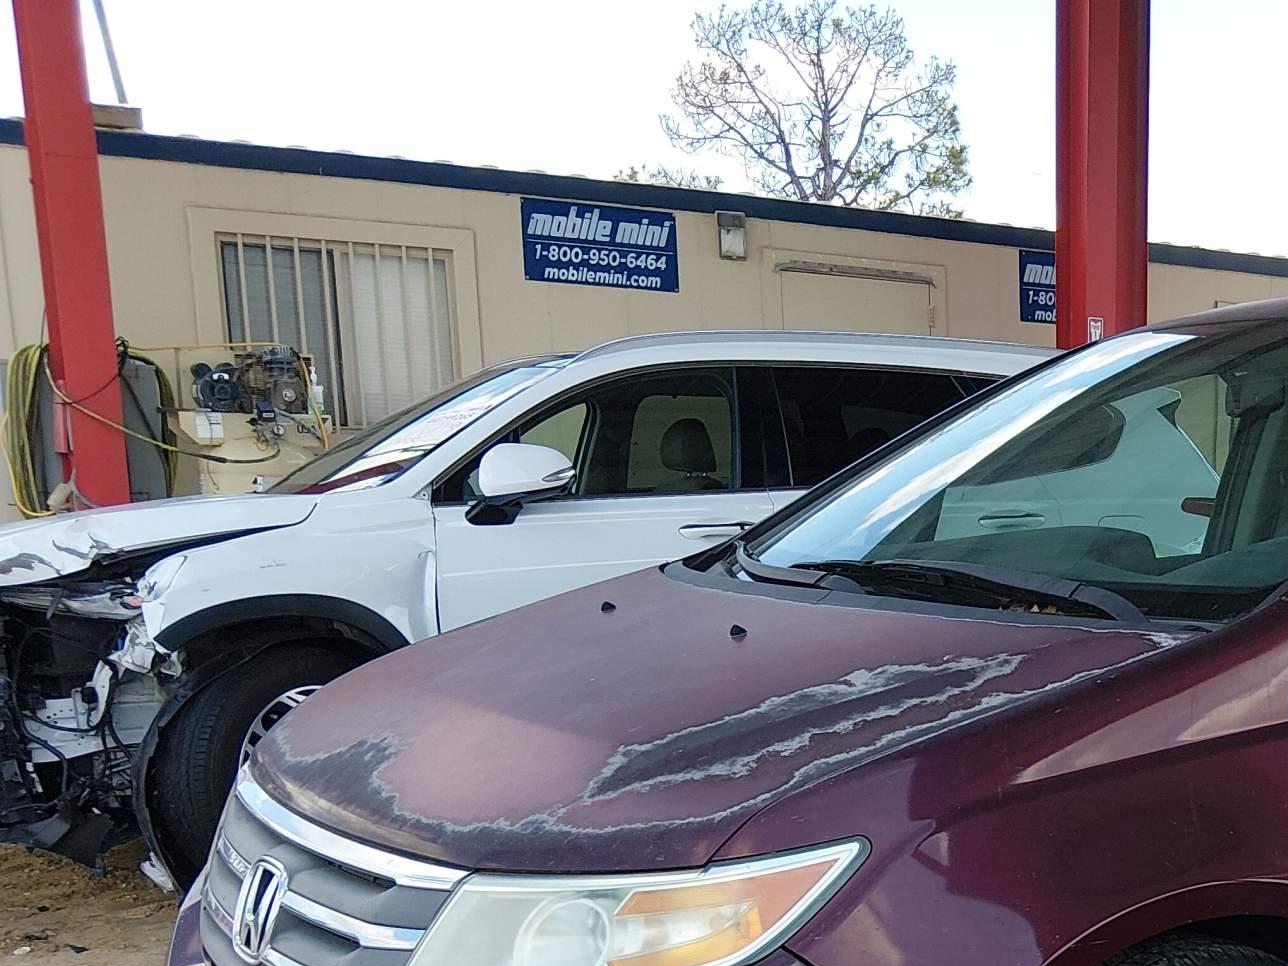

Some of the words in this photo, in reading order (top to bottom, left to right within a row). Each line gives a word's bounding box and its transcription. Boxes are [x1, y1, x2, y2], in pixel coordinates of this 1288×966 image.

[527, 206, 612, 241] mobile
[615, 219, 671, 247] mini
[535, 243, 666, 271] 1-800-950-6464
[544, 266, 661, 288] mobilemini.com
